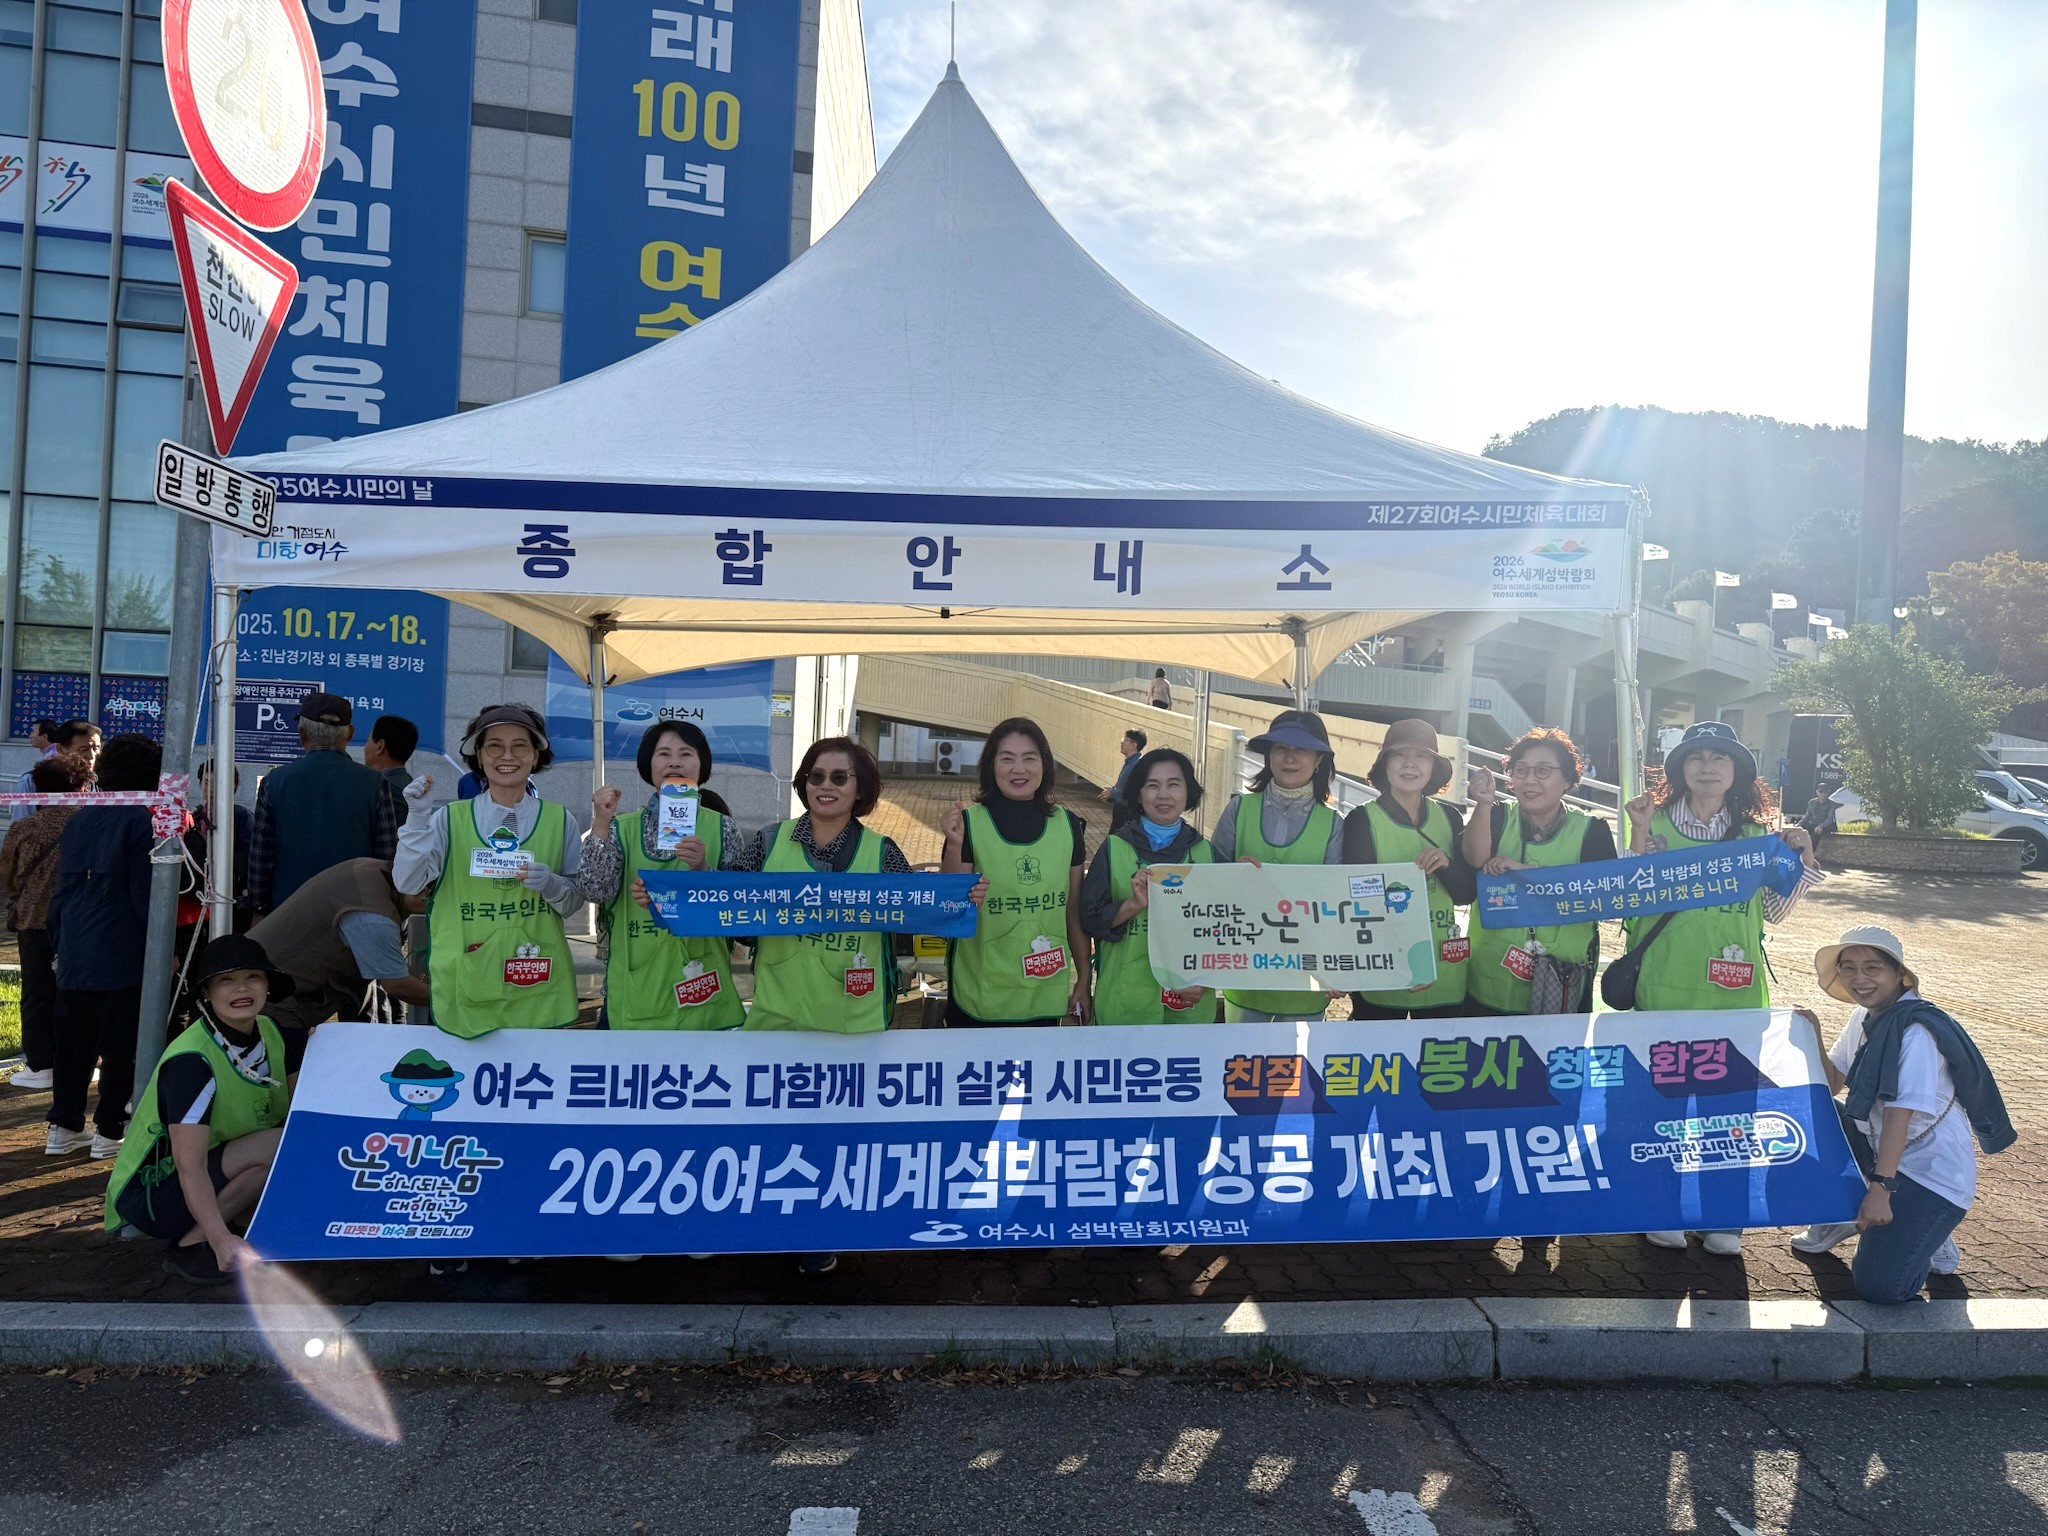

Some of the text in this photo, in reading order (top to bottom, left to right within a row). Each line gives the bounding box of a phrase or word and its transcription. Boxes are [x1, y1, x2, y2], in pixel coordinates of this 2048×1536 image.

[650, 0, 733, 73] 래
[209, 293, 255, 342] SLOW
[164, 453, 272, 529] 일방통행
[412, 480, 433, 501] 날
[1493, 556, 1524, 566] 2026
[1492, 568, 1595, 582] 여수세계섬박람회
[261, 649, 325, 666] 진남경기장
[328, 653, 341, 667] 외
[345, 653, 383, 669] 종목별
[387, 655, 425, 673] 경기장
[257, 704, 275, 730] P
[660, 706, 704, 721] 여수시
[1525, 882, 1564, 896] 2026
[1568, 875, 1625, 895] 여수세계
[1629, 864, 1656, 891] 섬
[1661, 863, 1702, 882] 박람회
[1706, 856, 1733, 874] 성공
[1737, 852, 1766, 870] 개최
[688, 889, 729, 903] 2026
[733, 889, 790, 904] 여수세계
[795, 882, 822, 906] 섬
[829, 890, 871, 905] 박람회
[876, 890, 903, 905] 성공
[908, 890, 935, 906] 개최
[1556, 899, 1603, 916] 반드시
[1611, 876, 1739, 910] 성공시키겠습니다
[460, 899, 551, 922] 한국부인회
[719, 908, 905, 926] 반드시 성공시키겠습니다
[1182, 902, 1246, 923] 하나되는
[1262, 899, 1385, 945] 온기나눔
[1193, 922, 1263, 945] 대한민국
[506, 961, 548, 975] 한국부인회
[1026, 950, 1062, 970] 한국부인회
[1183, 953, 1394, 971] 더 따뜻한 여수시를 만듭니다!
[1711, 962, 1751, 978] 한국부인회
[678, 975, 716, 998] 한국부인회
[473, 1038, 1729, 1110] 여수 르네상스 다함께 5대 실천 시민운동 친절 질서 봉사 청결 환경
[341, 1133, 501, 1194] 온기나눔
[1633, 1143, 1664, 1160] 5대
[1665, 1139, 1700, 1165] 실천
[539, 1124, 1611, 1216] 2026여수세계섬박람회 성공 개최 기원!
[384, 1175, 453, 1197] 하나되는
[389, 1197, 466, 1220] 대한민국
[328, 1224, 342, 1235] 더
[344, 1225, 380, 1236] 따뜻한
[978, 1218, 1250, 1241] 여수시 섬박람회지원과
